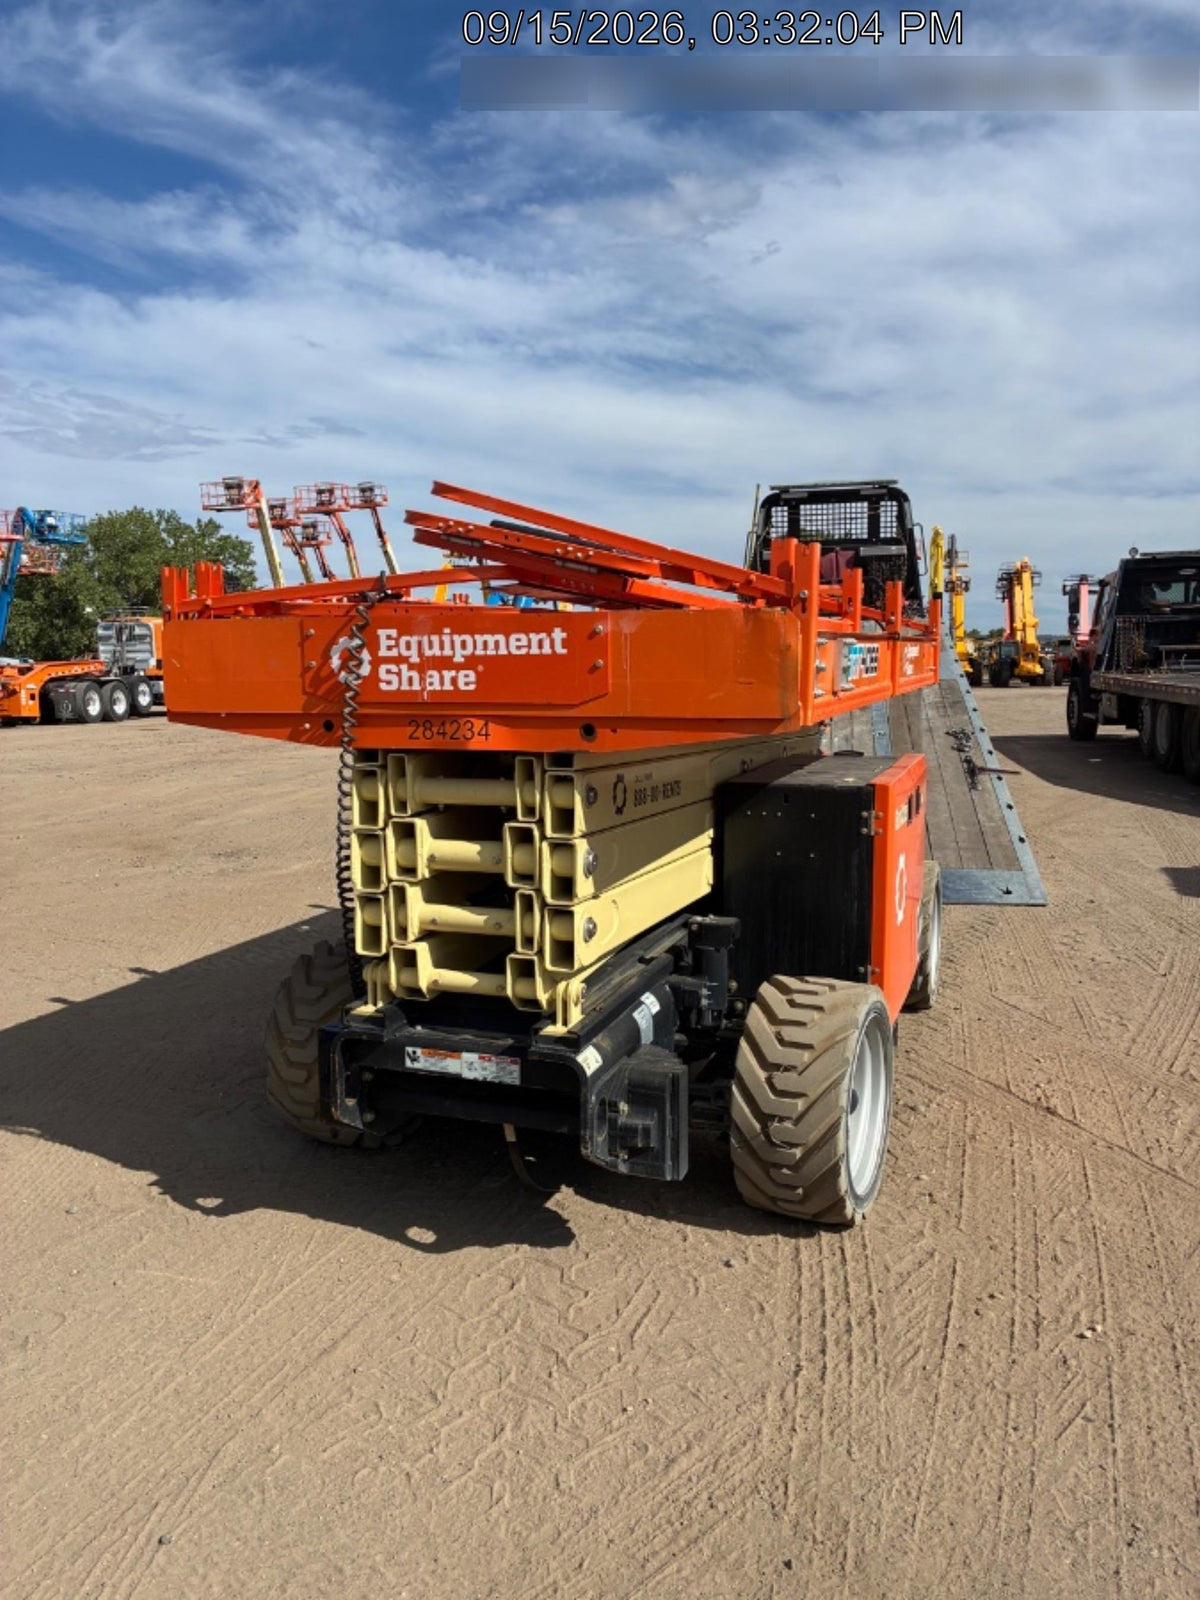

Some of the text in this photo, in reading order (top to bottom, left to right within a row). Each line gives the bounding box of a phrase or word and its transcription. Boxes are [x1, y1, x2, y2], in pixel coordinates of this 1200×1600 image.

[377, 627, 568, 662] Equipment
[378, 663, 477, 691] Share
[408, 719, 491, 741] 284234
